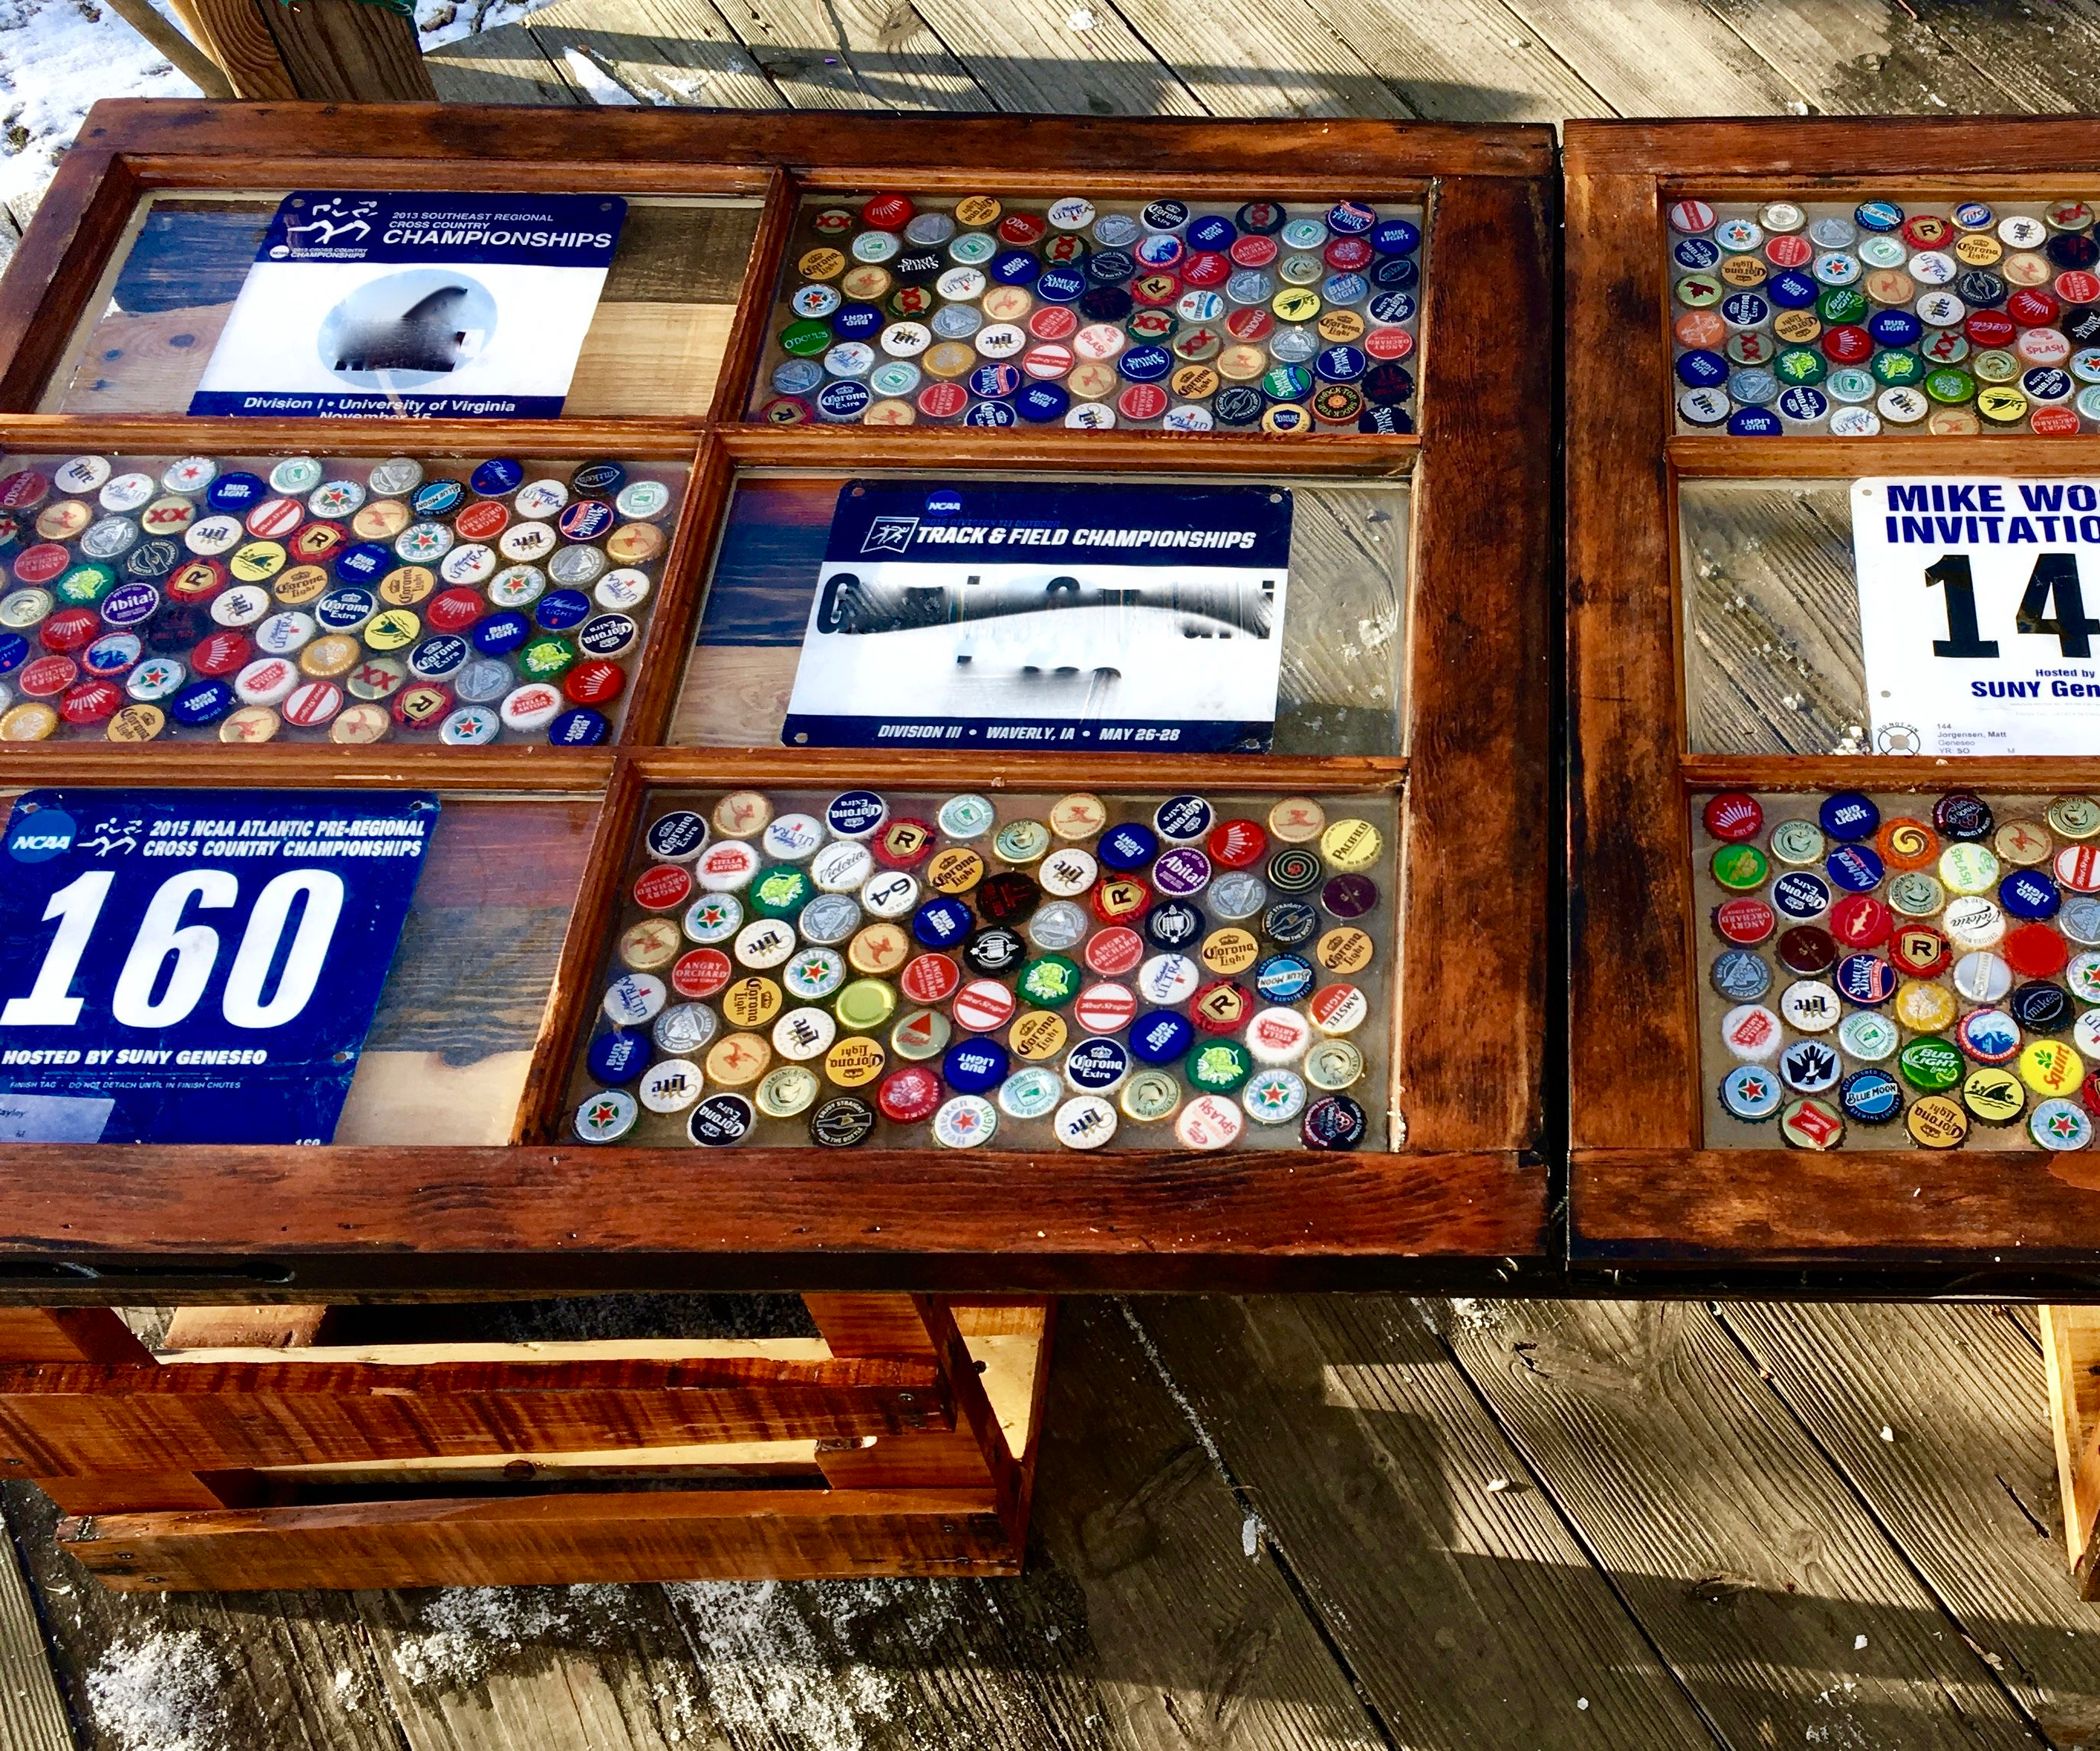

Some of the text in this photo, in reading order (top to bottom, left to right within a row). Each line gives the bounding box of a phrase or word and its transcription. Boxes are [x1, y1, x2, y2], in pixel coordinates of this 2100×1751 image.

[421, 213, 492, 221] SOUTHEAST
[494, 213, 554, 222] REGIONAL
[1148, 204, 1183, 223] Corona
[383, 229, 612, 248] CHAMPIONSHIPS
[1380, 234, 1410, 242] LIGHT
[1384, 228, 1405, 236] BUD
[1958, 242, 1999, 255] Corona
[802, 252, 841, 276] Corona
[1328, 274, 1359, 294] BLUE
[1880, 324, 1910, 332] LIGHT
[2026, 344, 2065, 355] SPLASH
[1178, 369, 1210, 396] Corona
[244, 397, 312, 409] Division
[338, 400, 425, 412] University
[429, 400, 447, 411] of
[451, 400, 516, 413] Virginia
[822, 391, 868, 406] Corona
[217, 489, 251, 498] LIGHT
[225, 483, 250, 493] BUD
[928, 501, 961, 511] NCAA
[1886, 484, 2100, 512] MIKE WO
[918, 526, 1257, 549] TRACK & FIELD CHAMPIONSHIPS
[276, 576, 326, 594] Corona
[106, 592, 155, 614] Abita!
[321, 599, 370, 614] Corona
[330, 610, 356, 620] Extra
[484, 627, 520, 641] LIGHT
[488, 623, 514, 634] BUD
[583, 622, 633, 644] Corona
[2035, 669, 2095, 678] Hosted by
[1971, 681, 2040, 697] SUNY
[878, 725, 1180, 741] DIVISION III WAVERLY, IA MAY 26-28
[1834, 809, 1869, 826] LIGHT
[1835, 804, 1861, 818] BUD
[150, 820, 425, 836] 2015 NCAA ATLANTIC PRE-REGIONAL
[658, 816, 695, 854] Corona
[12, 836, 71, 850] NCAA
[677, 826, 699, 848] Extra
[142, 840, 421, 856] CROSS COUNTRY CHAMPIONSHIPS
[711, 858, 743, 866] STELLA
[1950, 847, 1973, 886] SPLASH
[931, 854, 980, 888] Corona
[951, 868, 976, 888] Light
[1161, 854, 1205, 887] Abita!
[1, 868, 345, 1029] 160
[1092, 936, 1139, 967] ORCHARD
[1095, 933, 1126, 956] ANGRY
[1203, 943, 1255, 959] Corona
[1911, 939, 1932, 957] R
[684, 961, 722, 971] ANGRY
[1220, 955, 1246, 967] Light
[675, 969, 728, 978] ORCHARD
[1320, 989, 1348, 1016] LIGHT
[1325, 993, 1359, 1028] AMSTEL
[1146, 1021, 1168, 1042] BUD
[1150, 1022, 1179, 1052] LIGHT
[2, 1049, 267, 1065] HOSTED BY SUNY GENESEO
[1912, 1055, 1959, 1067] LIGHT
[1919, 1048, 1955, 1058] BUD
[1069, 1054, 1123, 1070] Corona
[2043, 1044, 2070, 1091] Squirt
[1082, 1069, 1111, 1079] Extra
[40, 1081, 57, 1089] TAG
[69, 1081, 81, 1089] DO
[83, 1081, 101, 1089] NOT
[103, 1081, 137, 1089] DETACH
[1872, 1084, 1897, 1099] MOON
[1846, 1091, 1872, 1105] BLUE
[980, 1105, 993, 1135] LIGHT
